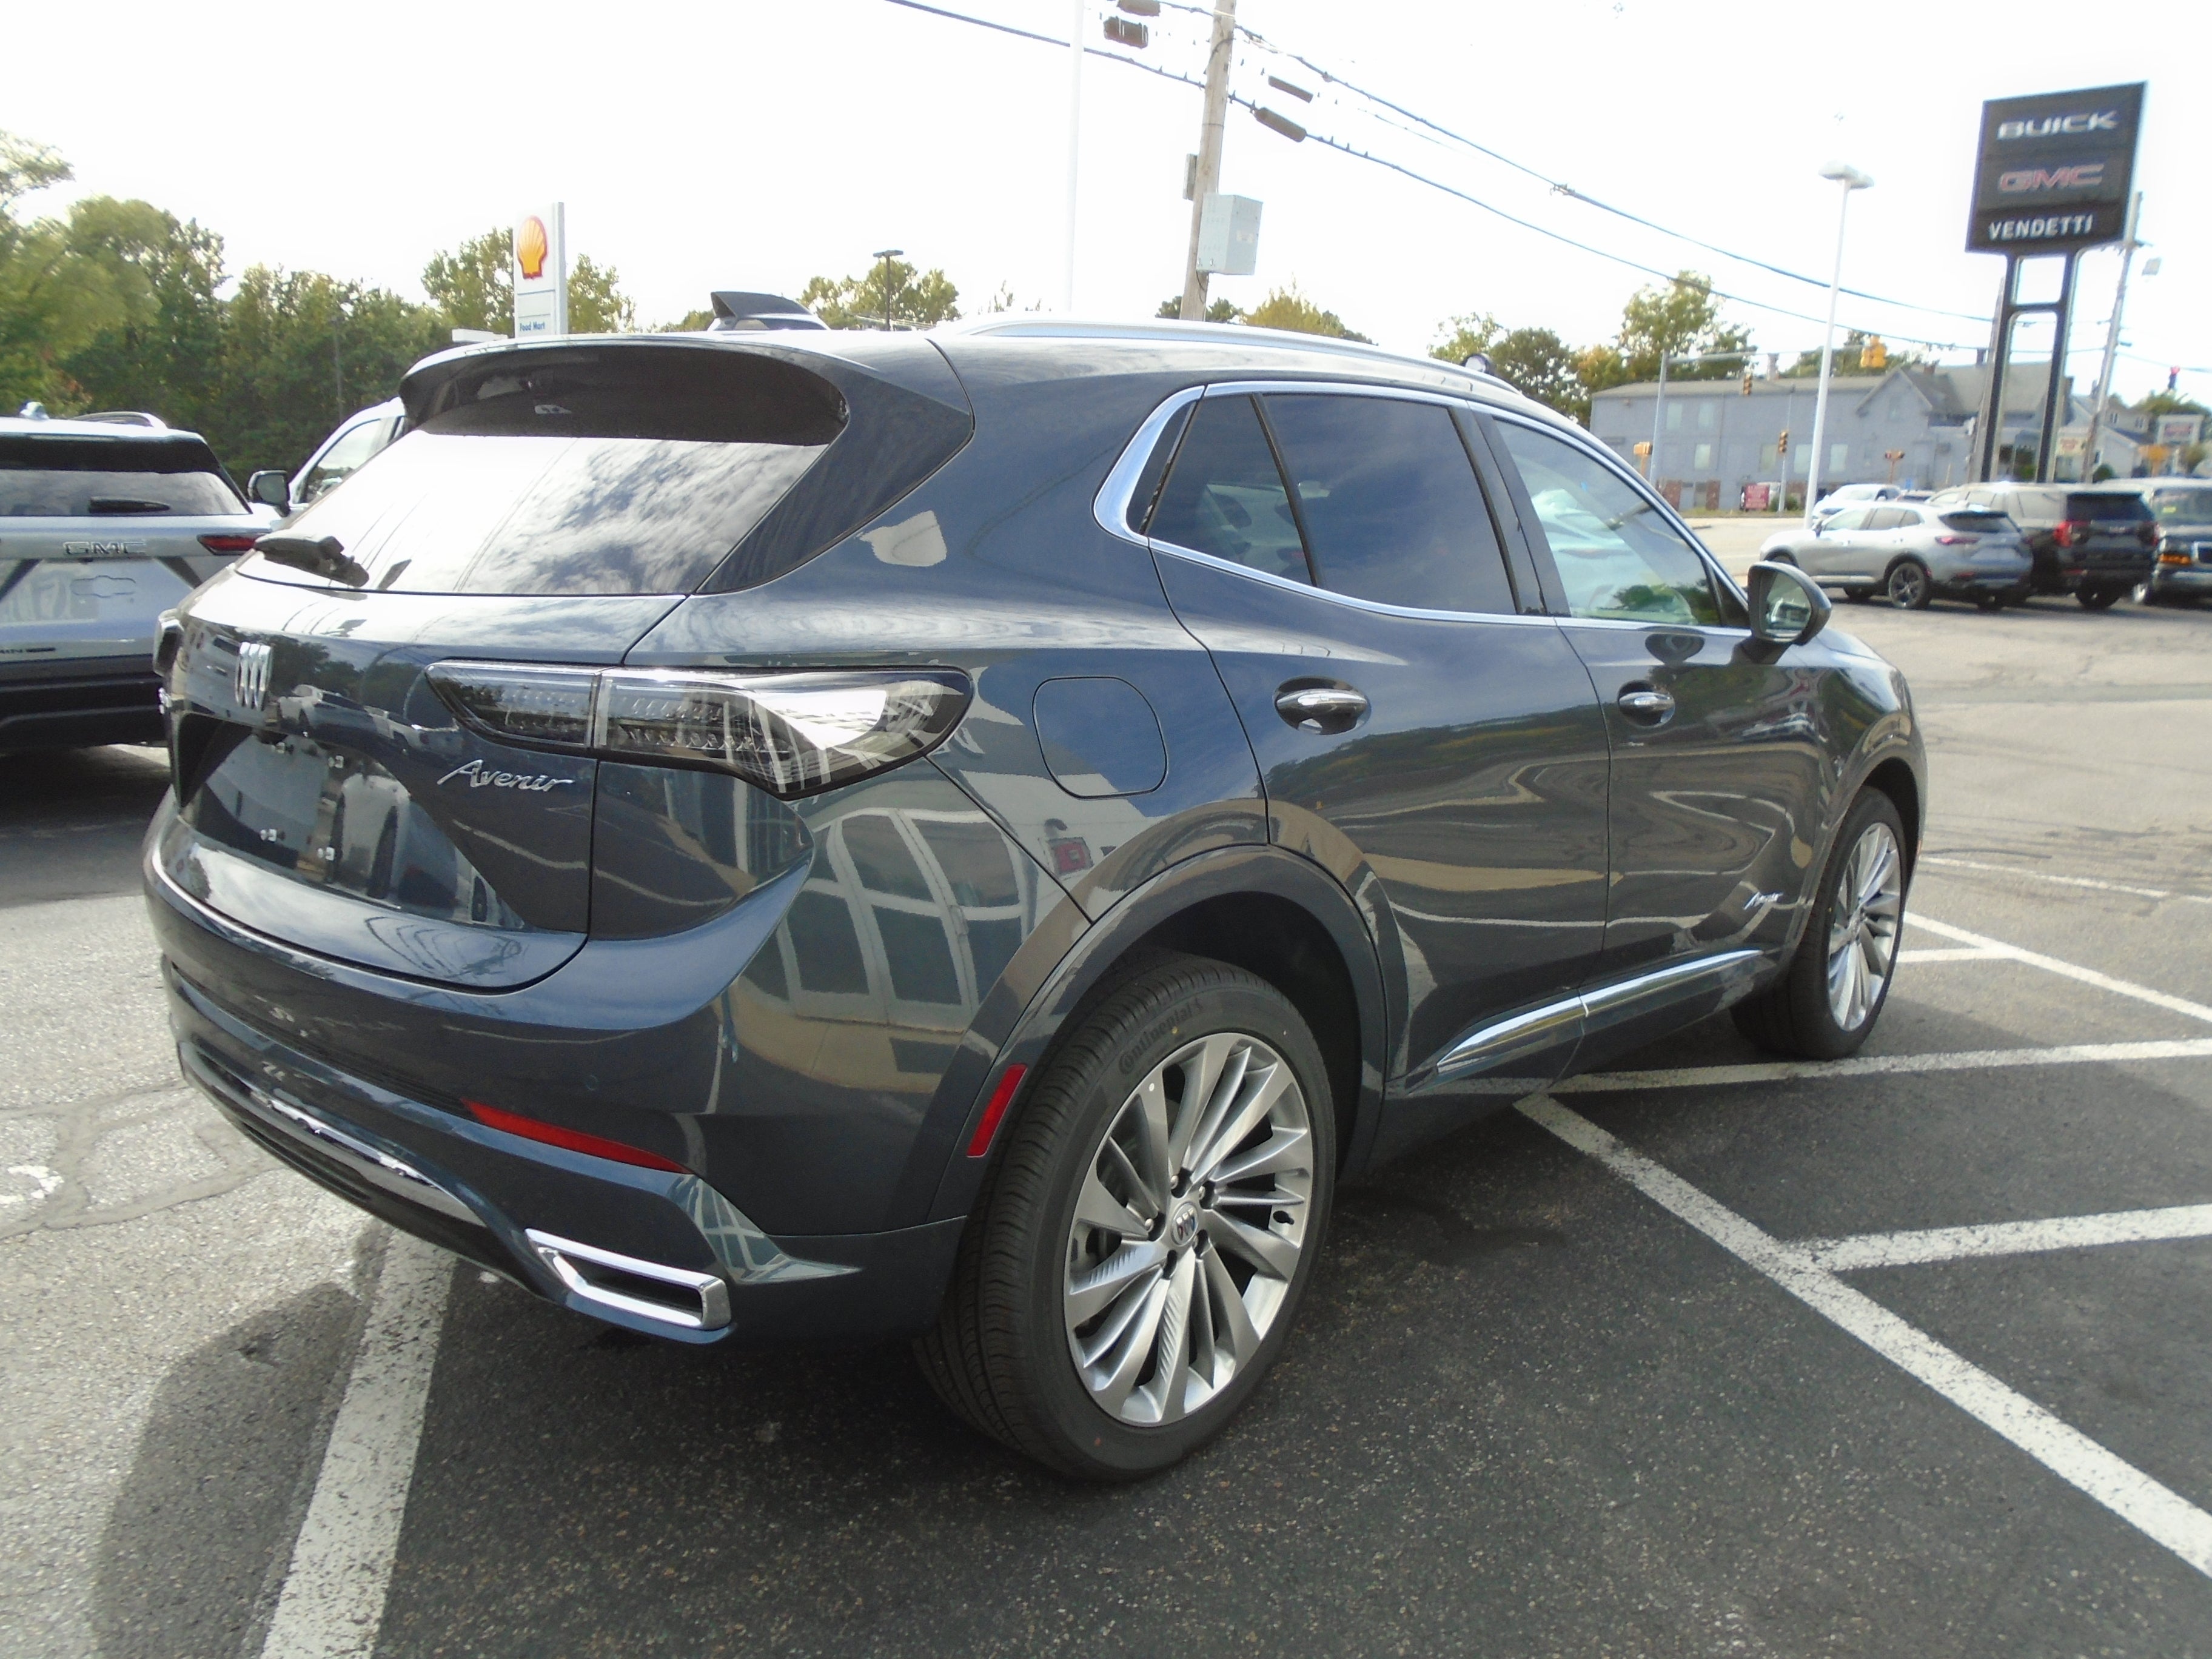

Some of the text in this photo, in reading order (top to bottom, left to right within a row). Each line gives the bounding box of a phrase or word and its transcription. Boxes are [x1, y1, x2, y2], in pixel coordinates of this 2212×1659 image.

[1997, 110, 2117, 140] BUICK
[1999, 164, 2104, 192] GMC
[1988, 213, 2094, 241] VENDETTI
[520, 321, 545, 332] Food Mart
[63, 540, 147, 554] GMC
[437, 759, 575, 792] Avenir
[1119, 1001, 1193, 1074] Continental
